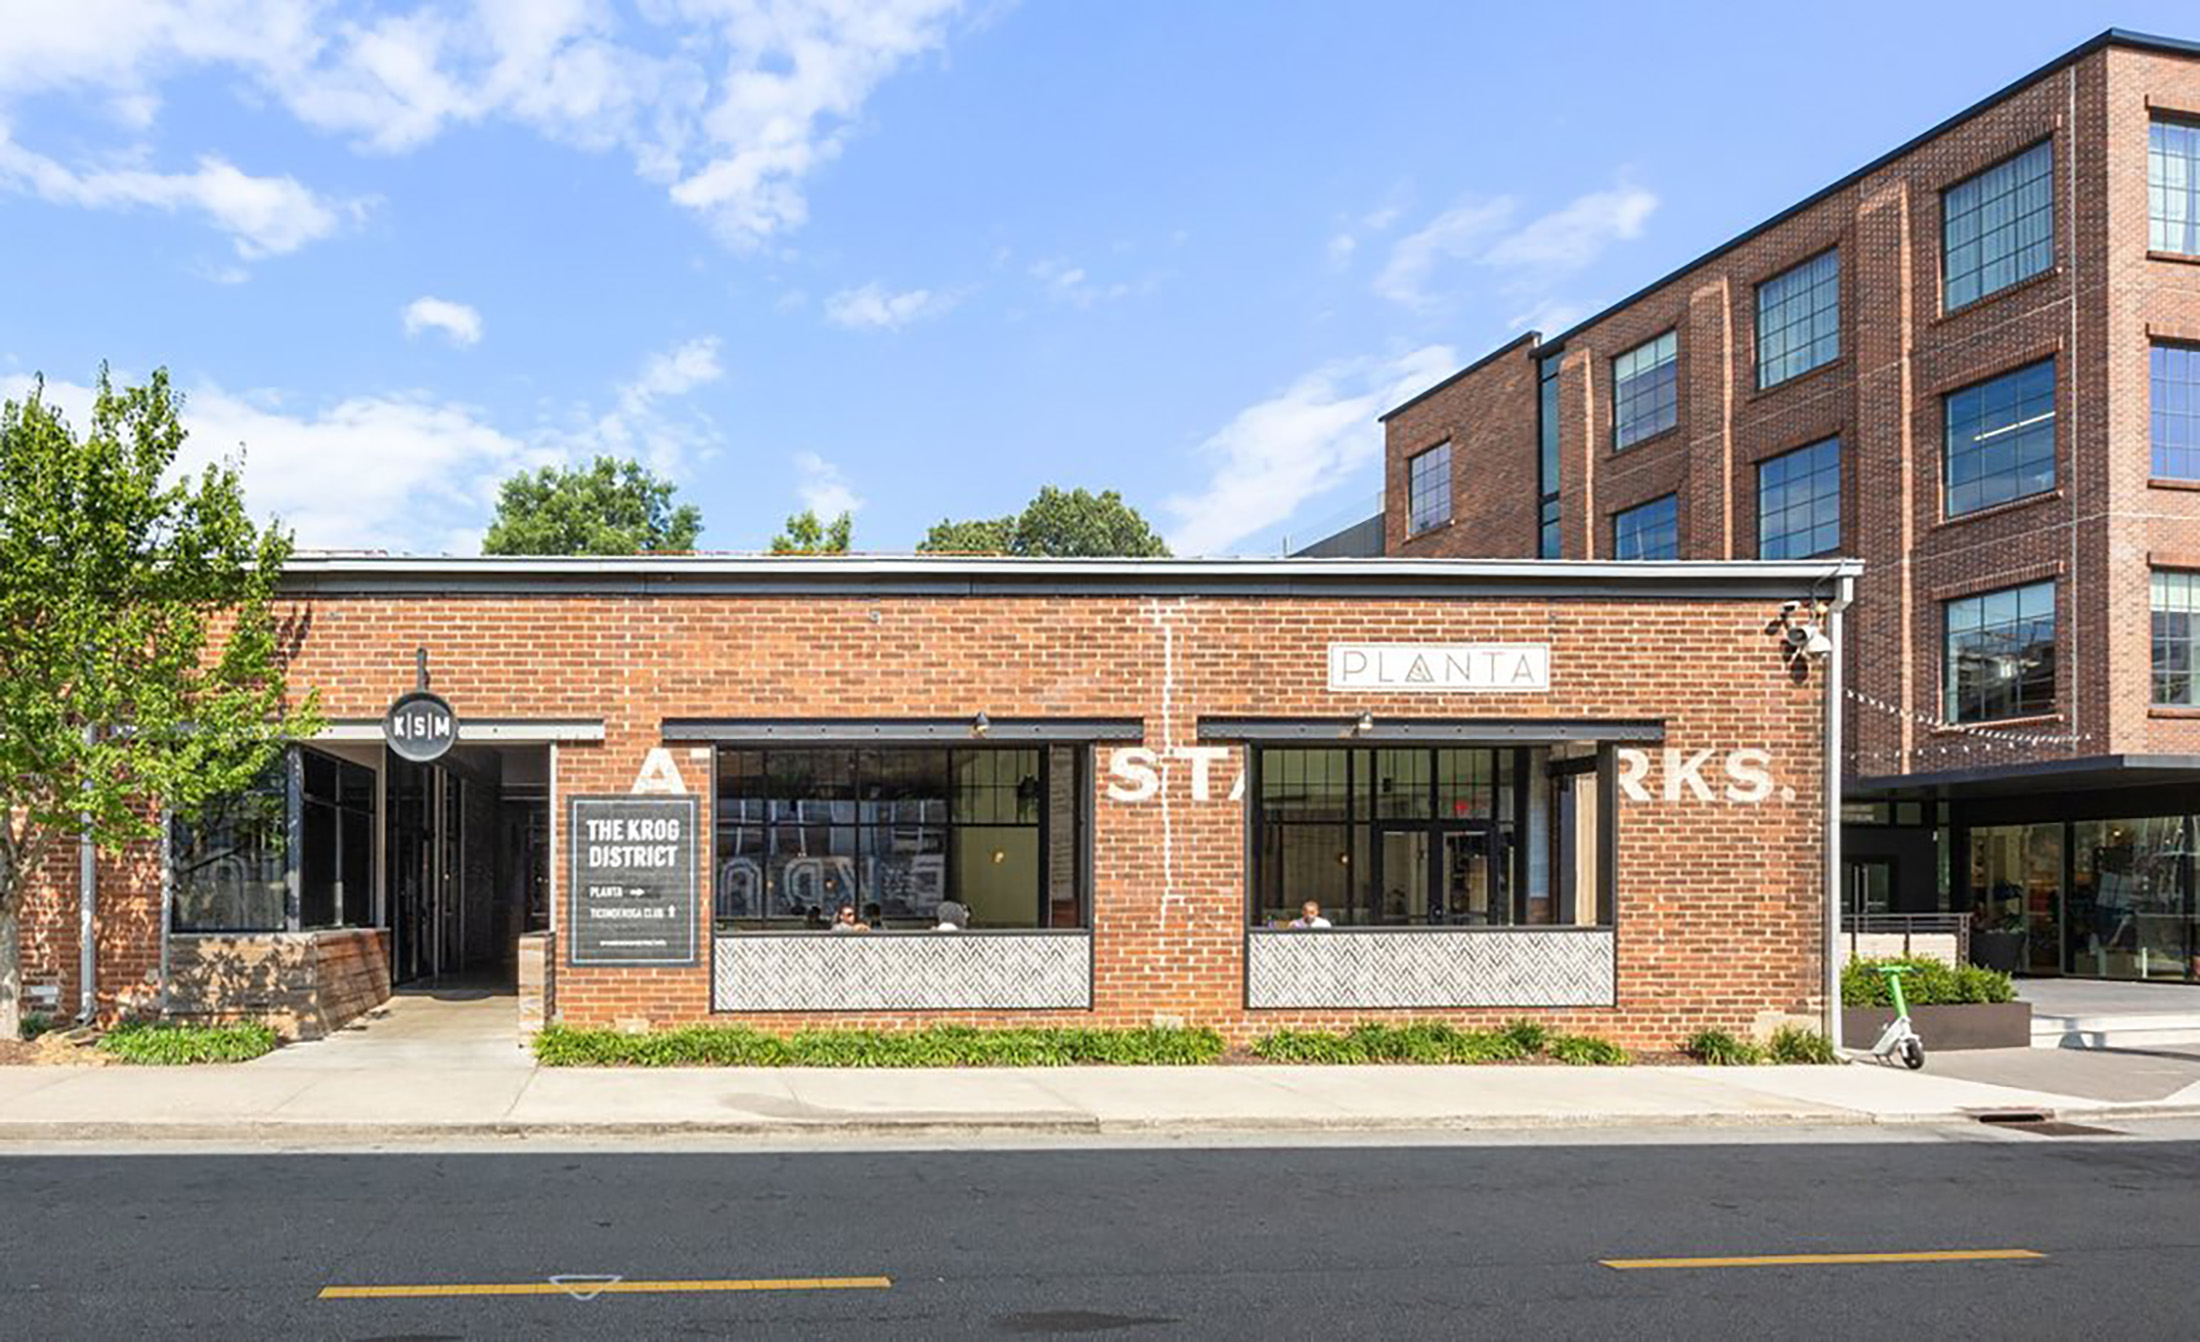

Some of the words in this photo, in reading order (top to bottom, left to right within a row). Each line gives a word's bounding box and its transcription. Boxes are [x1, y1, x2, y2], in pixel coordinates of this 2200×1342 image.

[1342, 651, 1535, 683] PLANTA
[1108, 747, 1245, 801] ST
[586, 819, 624, 841] THE
[627, 818, 680, 842] KROG
[589, 845, 678, 868] DISTRICT
[589, 886, 623, 898] PLANTA
